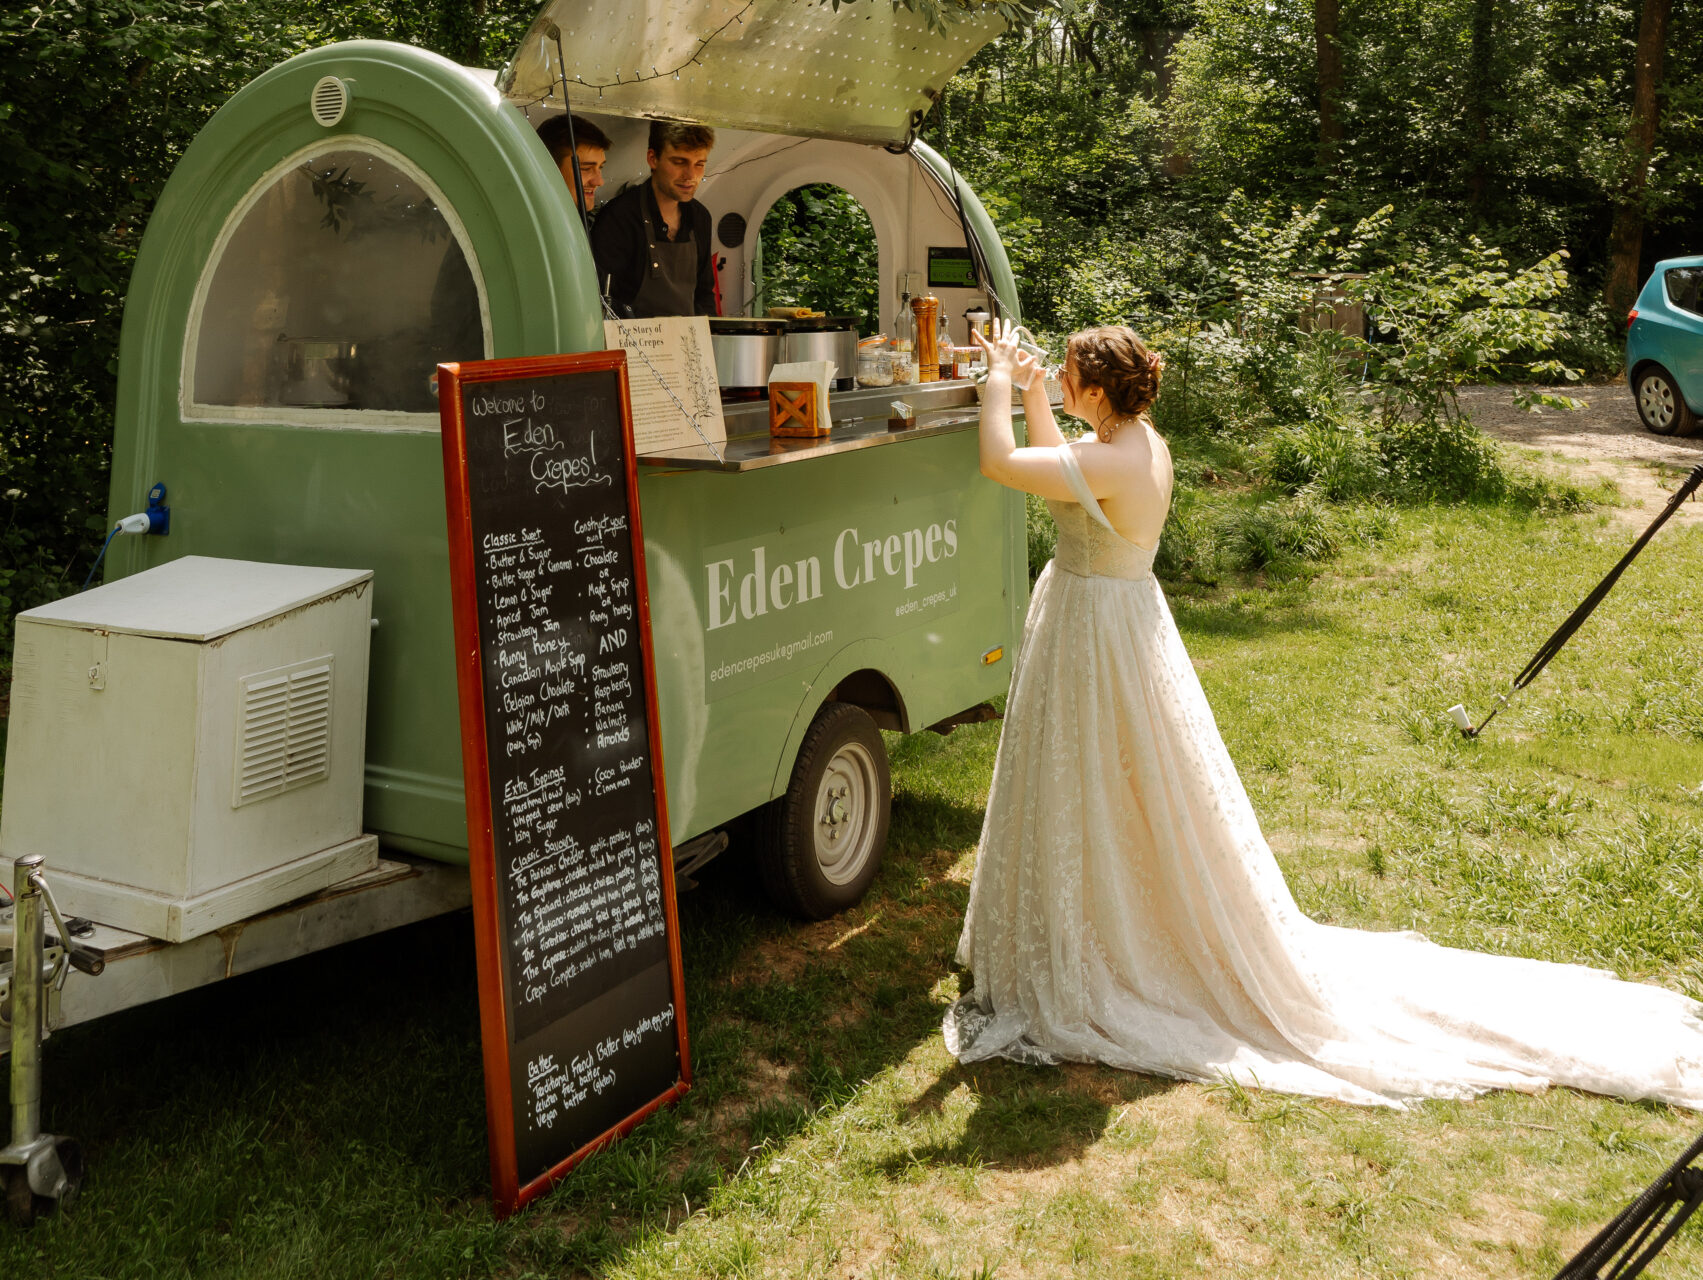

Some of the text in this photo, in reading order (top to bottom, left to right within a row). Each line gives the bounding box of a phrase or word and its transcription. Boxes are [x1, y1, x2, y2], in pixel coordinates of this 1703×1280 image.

[633, 325, 652, 336] Story
[655, 324, 662, 333] of
[639, 338, 664, 348] Crepes
[472, 389, 545, 416] Welcome to
[503, 418, 554, 449] Eden
[530, 430, 600, 494] Crepes!
[574, 513, 626, 538] Construct your
[483, 527, 542, 549] Classic Sweet
[490, 552, 517, 570] Butter
[528, 546, 552, 566] Sugar
[583, 550, 618, 568] Chocolate
[704, 519, 958, 632] Eden Crepes
[494, 593, 518, 610] Lemon
[530, 583, 553, 603] Sugar
[588, 577, 629, 600] Maple Syrup
[895, 581, 957, 617] @eden_crepes_uk
[496, 603, 549, 631] Apricot Jam
[589, 603, 632, 627] Runny honey
[498, 618, 561, 646] Strawberry Jam
[599, 628, 627, 655] AND
[500, 635, 571, 669] Runny honey
[710, 630, 833, 682] edencrepesuk@gmail.com
[501, 663, 541, 689] Canadian
[545, 653, 567, 682] Maple
[592, 662, 629, 681] Strawberry
[503, 677, 575, 718] Belgian Chocolate
[594, 680, 632, 701] Raspberry
[594, 700, 625, 718] Banana
[595, 712, 627, 732] Walnuts
[597, 725, 630, 750] Almonds
[594, 756, 643, 784] Cocoa Powder
[504, 765, 565, 800] Extra Toppings
[595, 776, 631, 796] Cinnamon
[511, 786, 563, 815] Marshmallows
[513, 807, 541, 829] Whipped
[536, 818, 557, 838] Sugar
[609, 828, 632, 851] parsley
[511, 834, 575, 872] Classic Savoury
[516, 890, 529, 907] The
[518, 910, 532, 928] The
[521, 928, 535, 946] The
[522, 947, 536, 963] The
[522, 963, 540, 982] The
[525, 982, 547, 1006] Crepe
[528, 1054, 553, 1078] Batter
[533, 1064, 569, 1099] Traditional
[571, 1050, 594, 1078] French
[596, 1035, 620, 1061] Batter
[579, 1066, 600, 1087] batter
[563, 1087, 588, 1110] batter
